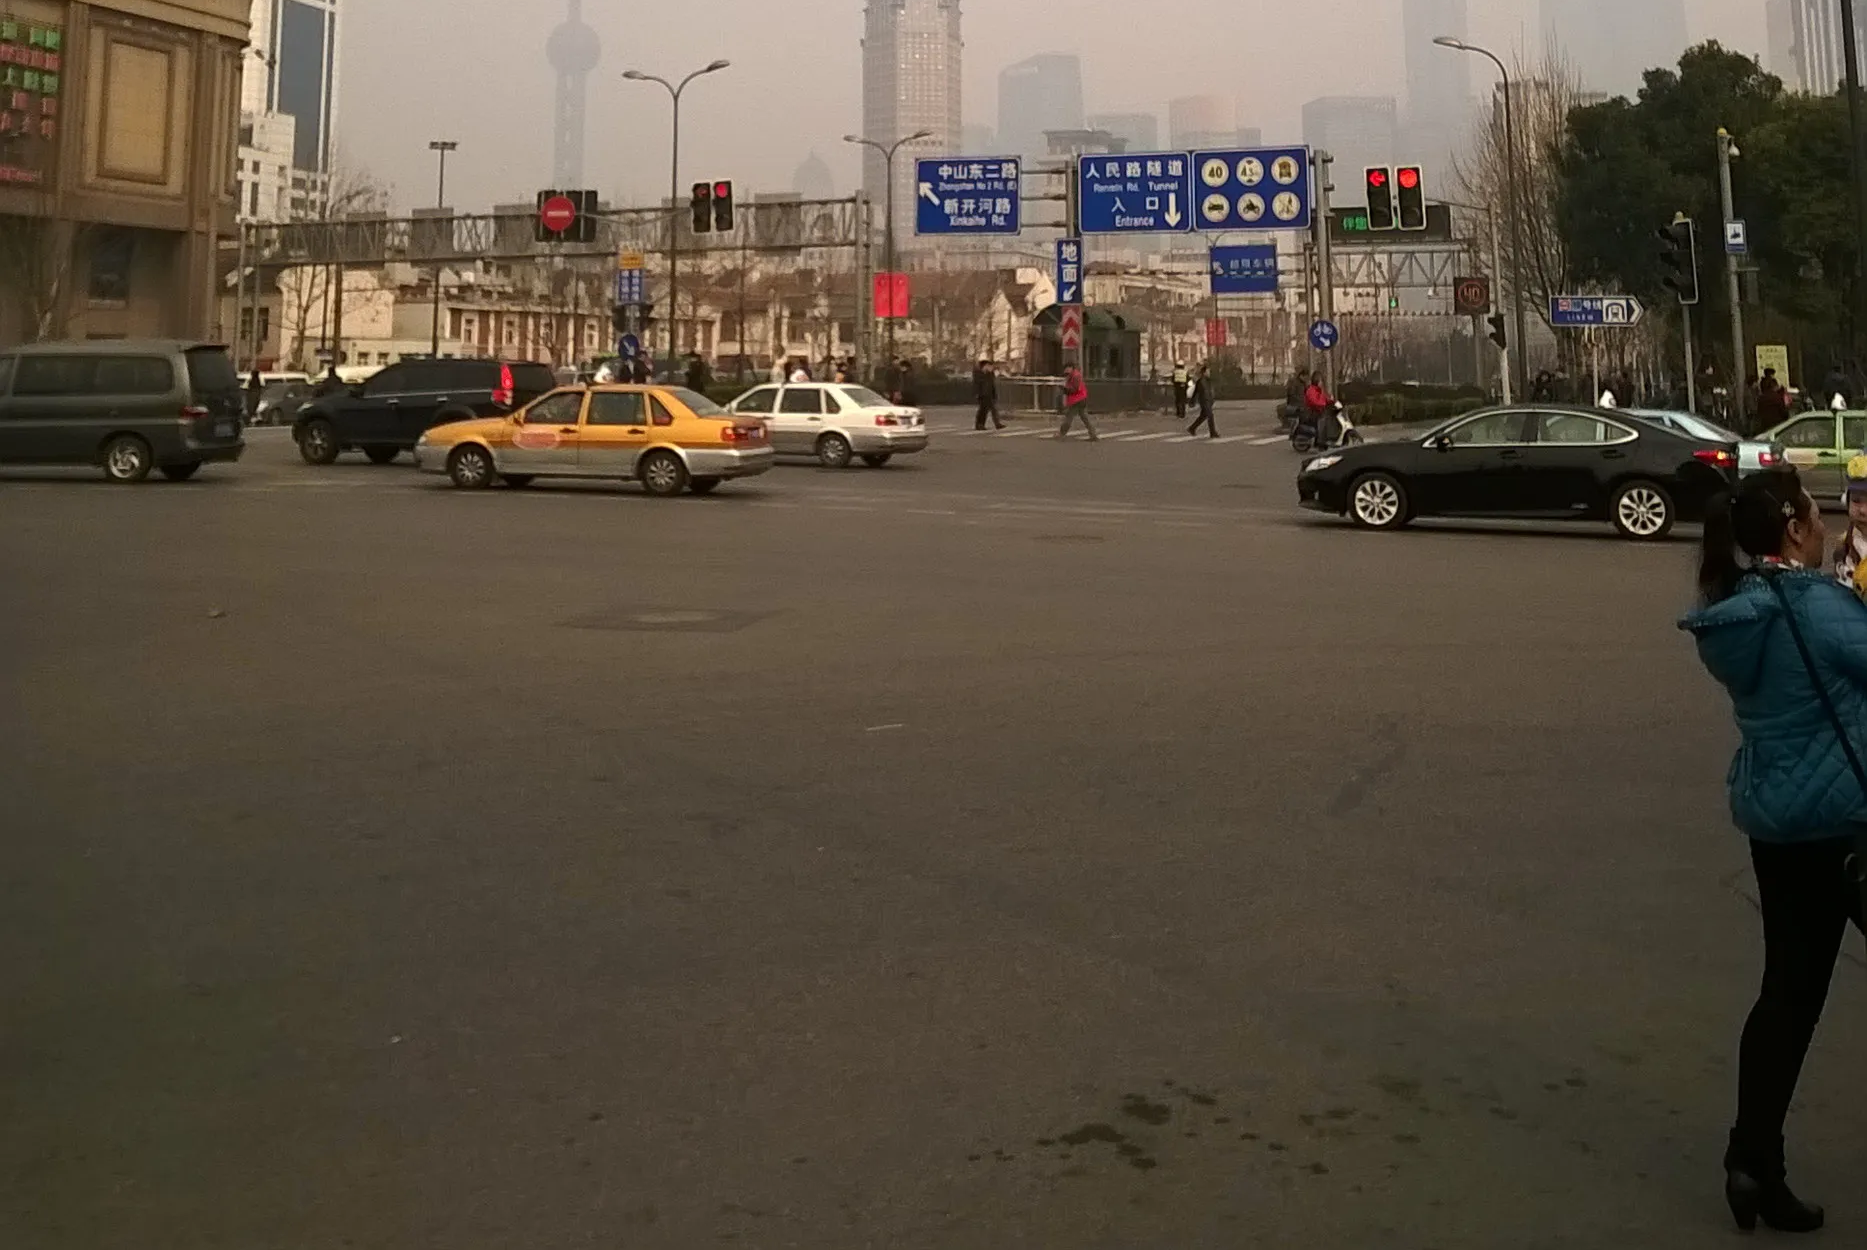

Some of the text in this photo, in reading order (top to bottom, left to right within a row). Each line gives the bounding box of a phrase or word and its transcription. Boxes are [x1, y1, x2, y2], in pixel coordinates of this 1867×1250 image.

[938, 163, 1017, 180] 中山东二路
[1086, 160, 1183, 179] 人民路隧道
[1208, 166, 1223, 178] 40
[1093, 183, 1123, 192] Renmin
[1148, 181, 1178, 191] Tunnel
[943, 198, 1011, 214] 新开河路
[1111, 196, 1159, 212] 入口
[1115, 215, 1154, 227] Entrance
[1061, 242, 1079, 283] 地面
